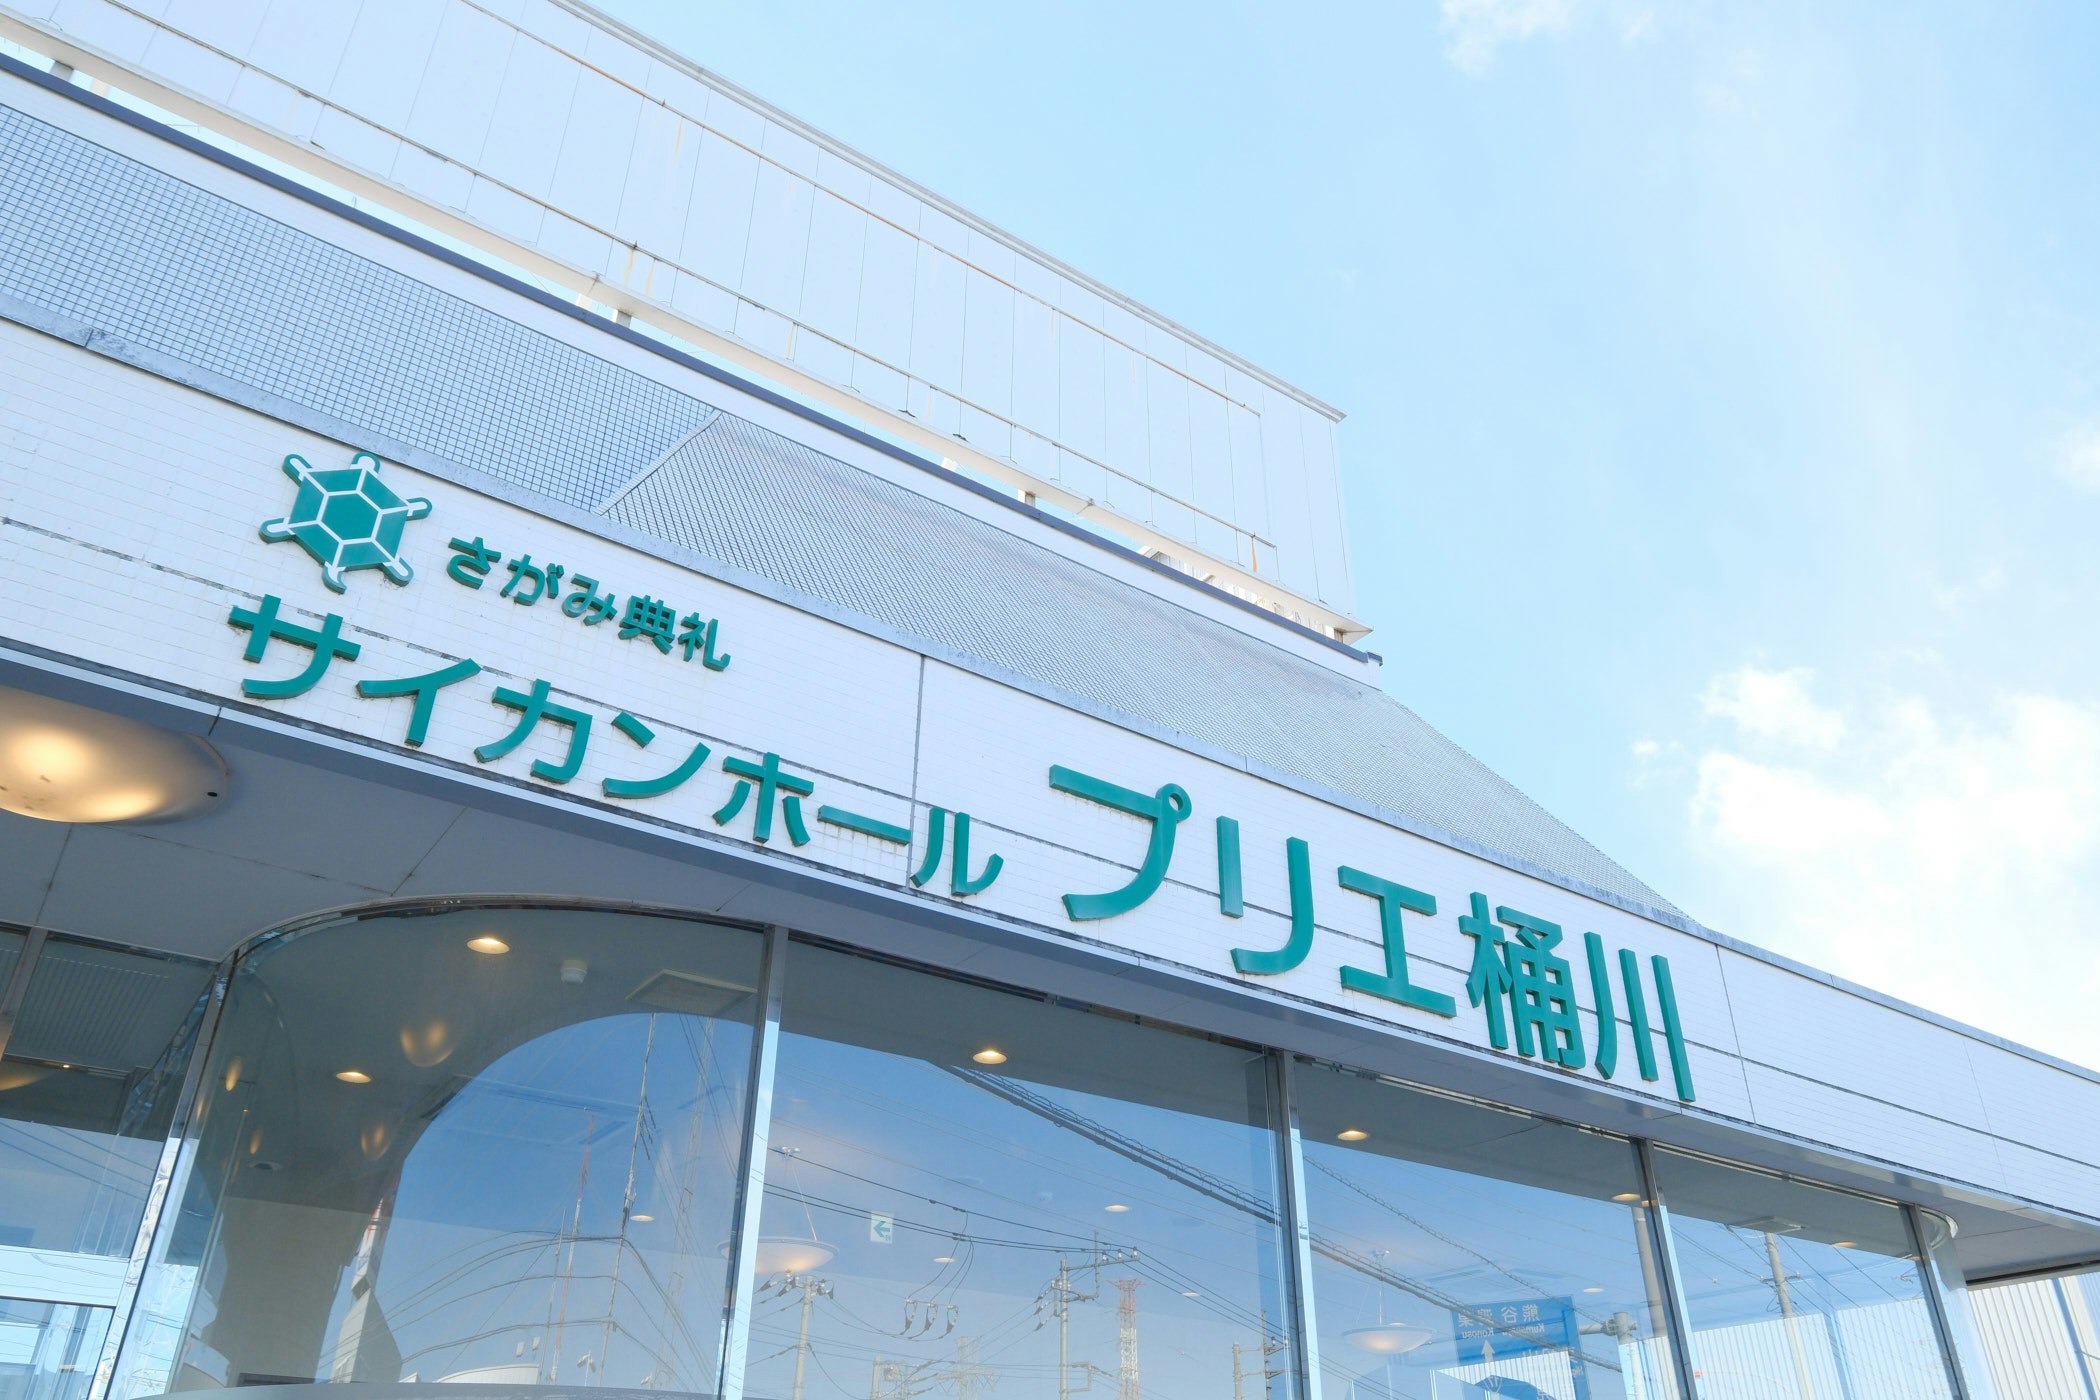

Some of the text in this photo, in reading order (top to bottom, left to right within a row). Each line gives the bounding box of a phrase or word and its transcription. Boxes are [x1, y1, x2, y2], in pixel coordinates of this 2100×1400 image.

[446, 536, 732, 672] さがみ典礼
[228, 594, 1697, 1103] サイカンホール プリエ桶川
